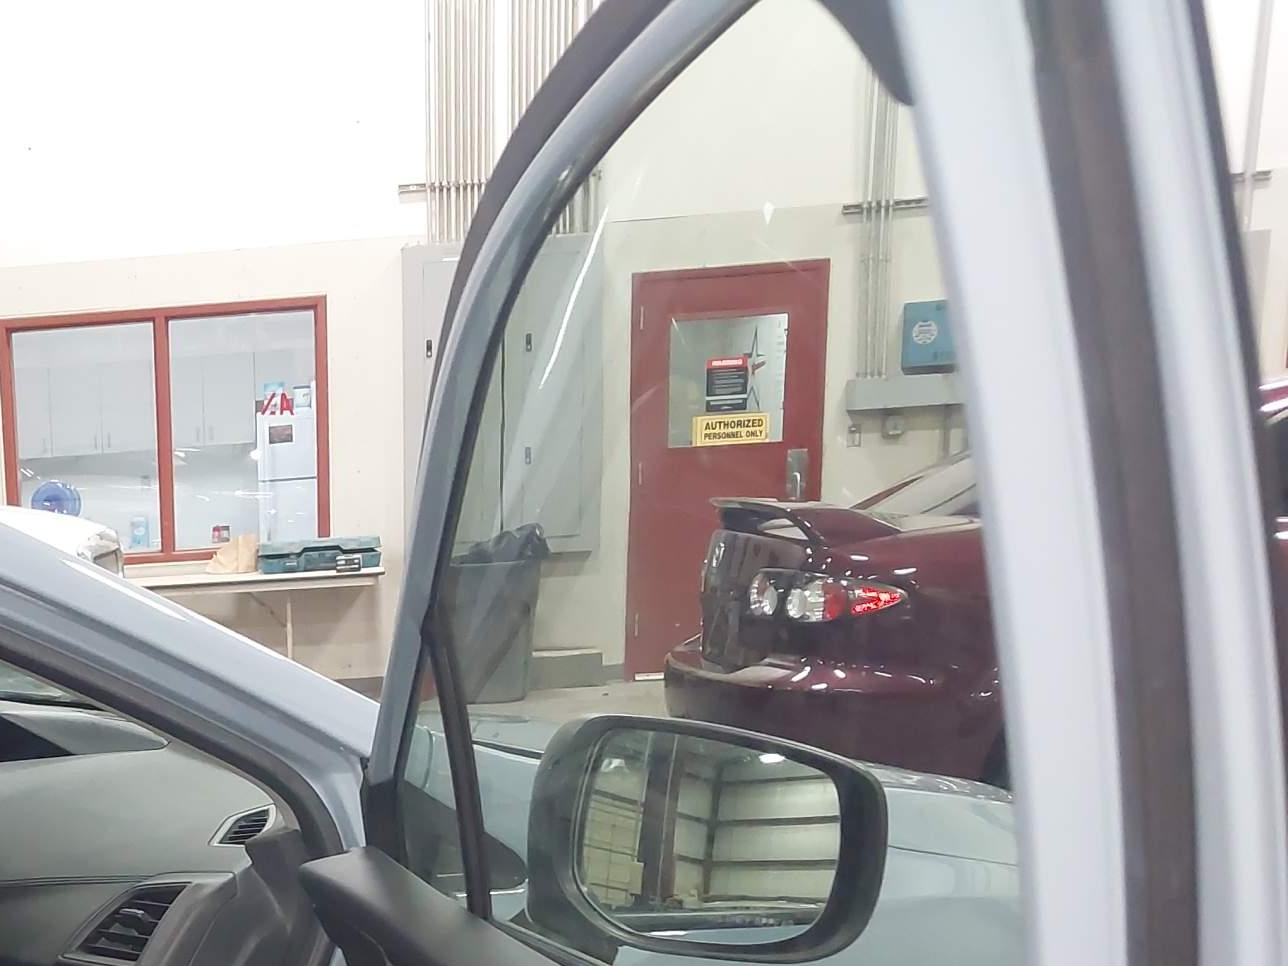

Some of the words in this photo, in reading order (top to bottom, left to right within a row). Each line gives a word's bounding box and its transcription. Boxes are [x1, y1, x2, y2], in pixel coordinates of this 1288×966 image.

[704, 418, 764, 431] AUTHORIZED
[703, 430, 743, 440] PERSONNEL
[745, 430, 763, 438] ONLY
